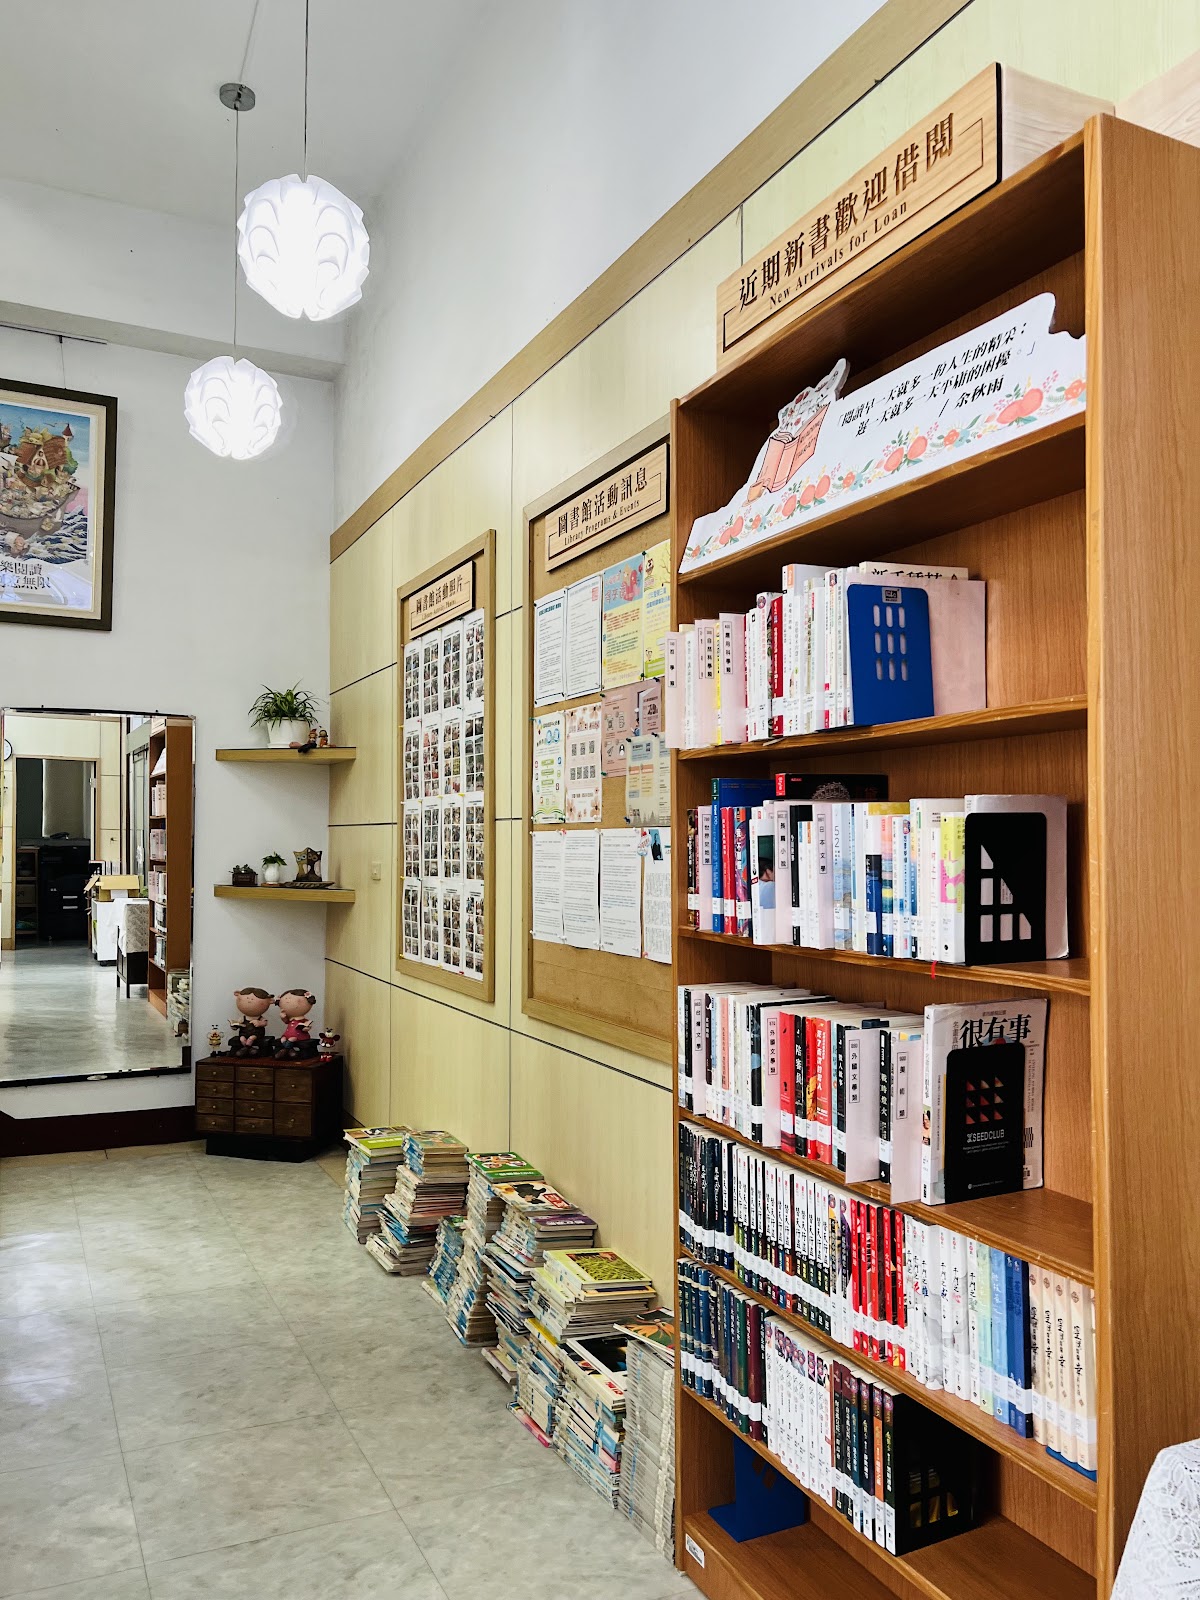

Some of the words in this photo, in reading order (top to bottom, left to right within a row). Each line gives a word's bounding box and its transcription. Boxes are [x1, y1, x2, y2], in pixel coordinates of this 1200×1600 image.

[738, 112, 954, 313] 近期新書歡迎借閱
[769, 286, 791, 310] New
[795, 249, 844, 291] Arrivals
[849, 230, 868, 253] for
[873, 201, 908, 235] Loan
[558, 467, 647, 537] 圖書館活動訊息
[564, 531, 584, 546] Library
[585, 515, 611, 536] Programs
[612, 509, 618, 519] &
[619, 499, 640, 516] Events
[416, 574, 463, 614] 圖書館活動照片
[959, 1013, 1032, 1049] 很有事
[973, 1129, 1005, 1142] SEEDCLUB
